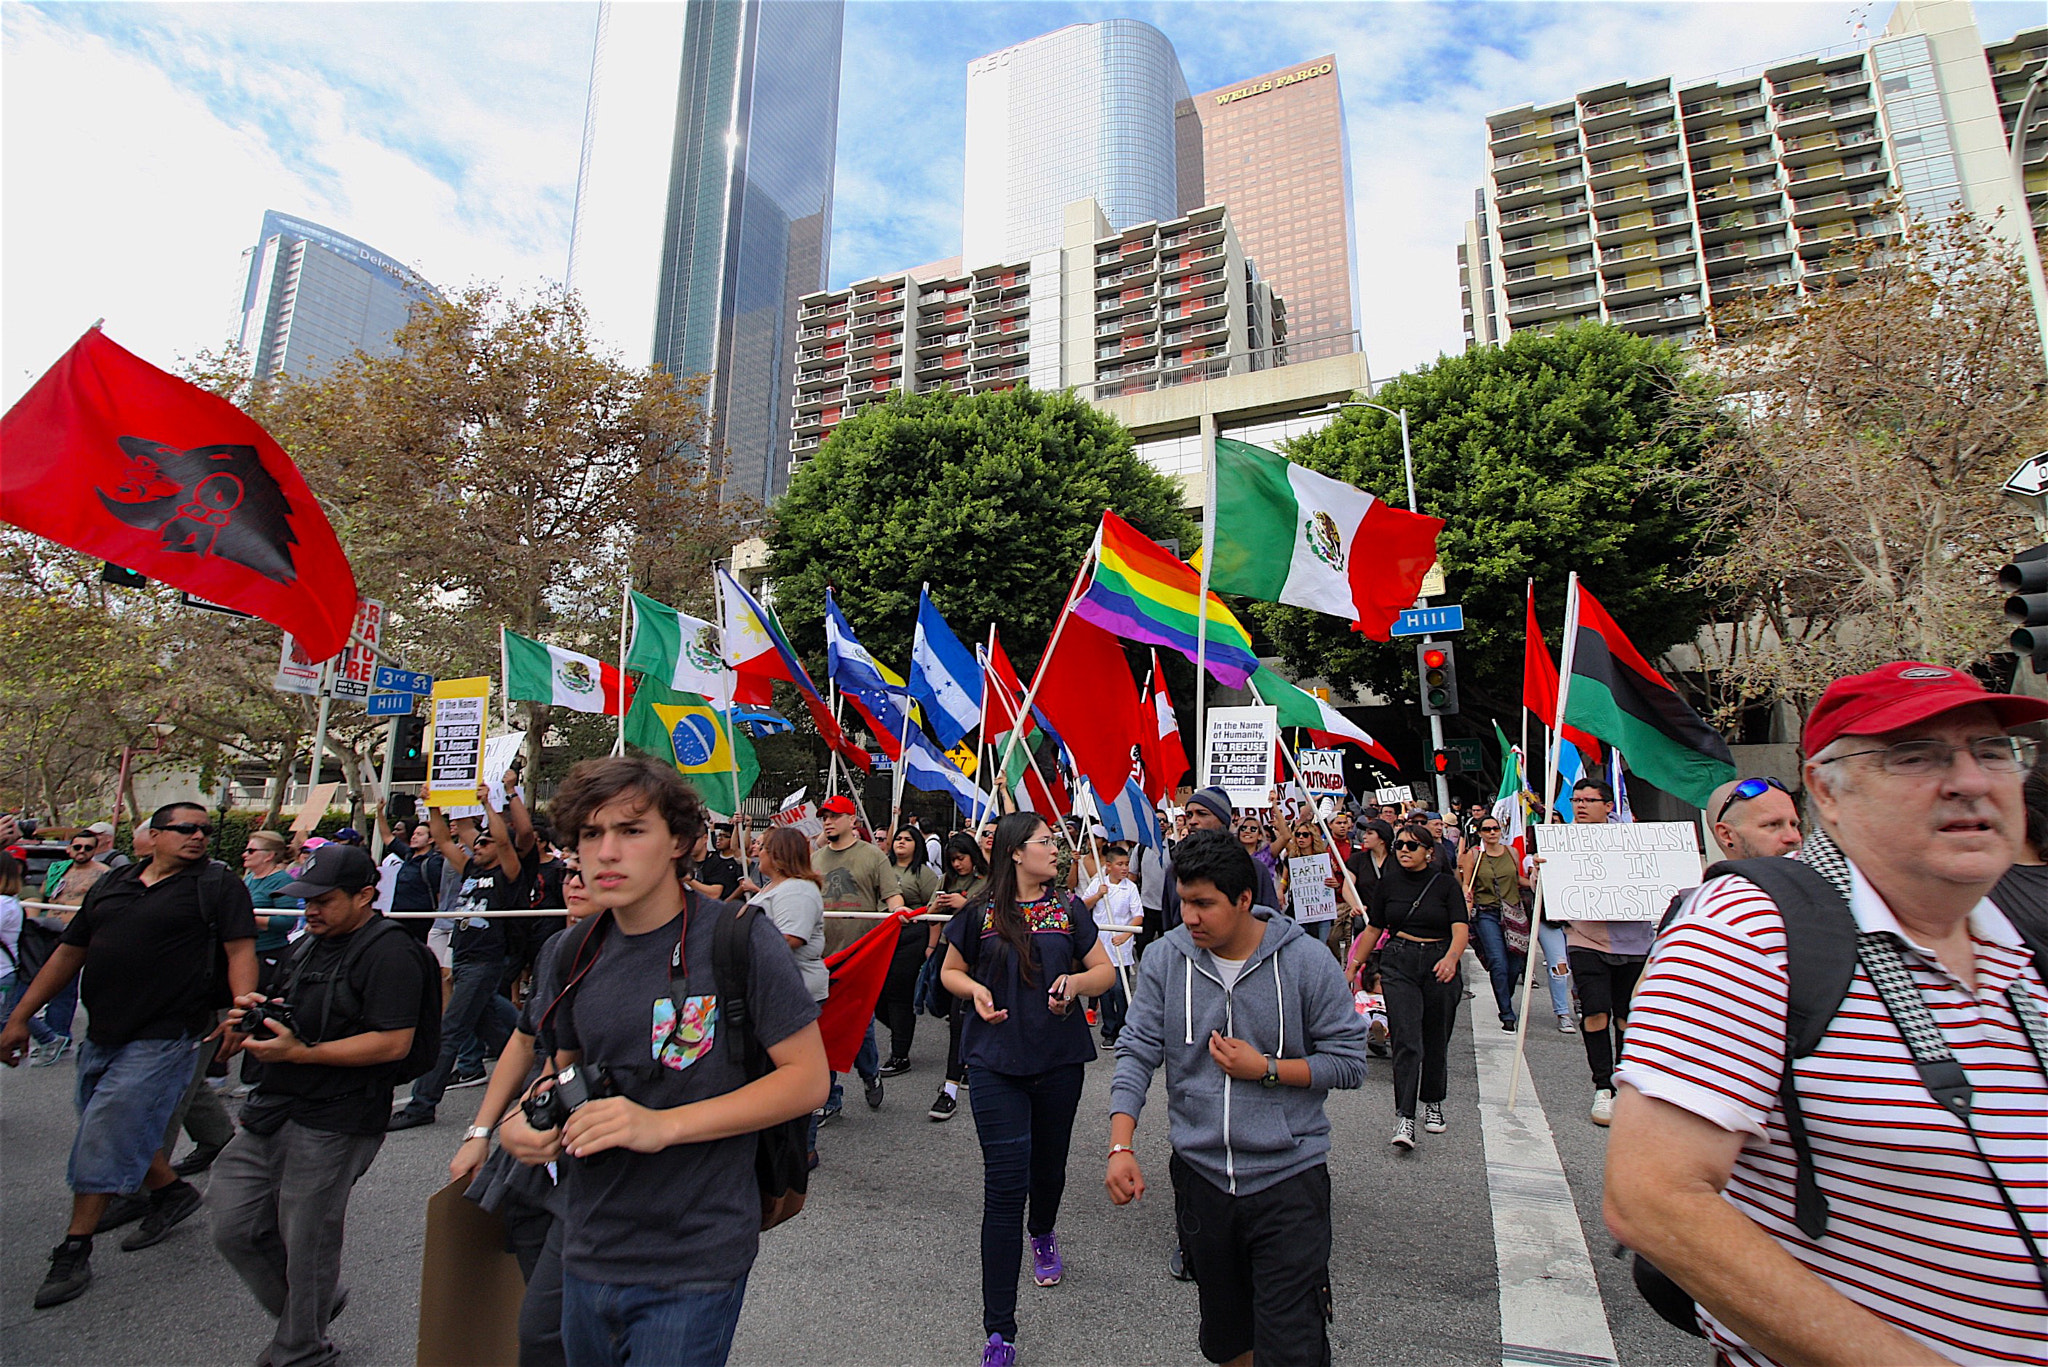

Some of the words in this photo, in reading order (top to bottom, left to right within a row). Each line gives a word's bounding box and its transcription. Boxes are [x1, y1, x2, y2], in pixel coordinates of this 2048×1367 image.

[1215, 80, 1272, 106] WELLS
[1276, 63, 1333, 89] FARGO
[1407, 611, 1446, 628] Hill
[381, 671, 406, 686] 3rd
[412, 675, 428, 691] St
[377, 697, 403, 710] Hill
[448, 725, 479, 737] REFUSE
[1213, 722, 1222, 730] In
[1224, 721, 1238, 730] the
[1240, 721, 1264, 730] Name
[1213, 731, 1222, 739] of
[1224, 730, 1265, 740] Humanity,
[1214, 742, 1228, 751] We
[1229, 742, 1266, 751] REFUSE
[1219, 753, 1228, 762] To
[1229, 753, 1260, 763] Accept
[1301, 750, 1337, 770] STAY
[1227, 764, 1258, 773] Fascist
[1220, 775, 1256, 785] America
[1301, 770, 1344, 791] OUTRAGED
[1378, 786, 1411, 804] LOVE
[770, 805, 807, 828] TRUMP
[1538, 823, 1699, 852] IMPERIALISM
[1302, 856, 1316, 864] THE
[1571, 853, 1607, 881] IS
[1623, 852, 1660, 879] IN
[1291, 863, 1326, 878] EARTH
[1293, 885, 1320, 898] BETTER
[1301, 895, 1320, 905] THAN
[1304, 902, 1334, 917] TRUMP
